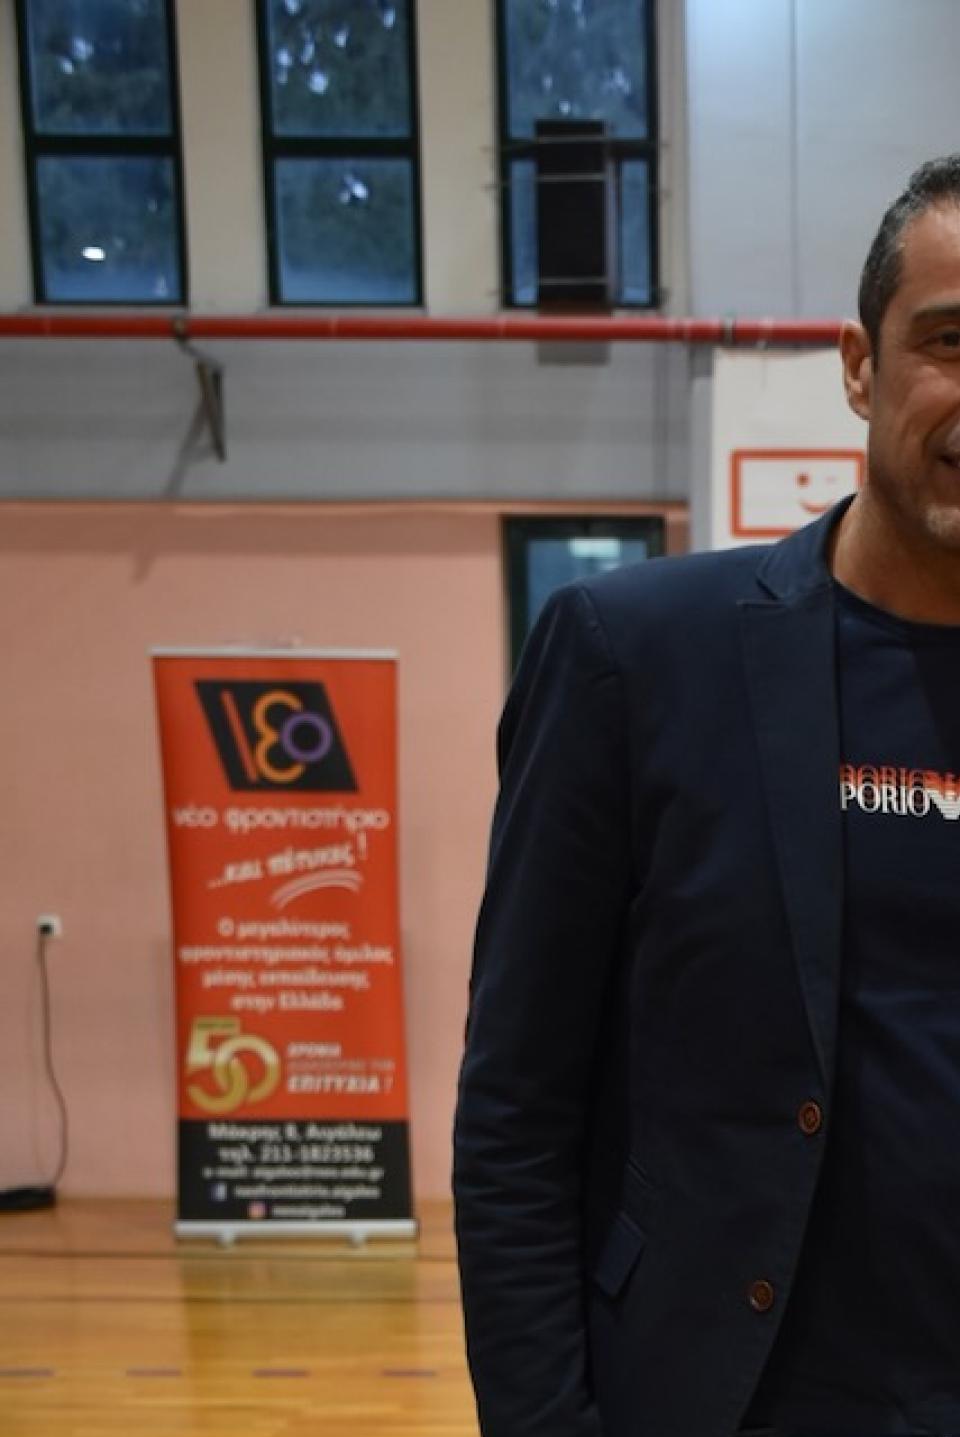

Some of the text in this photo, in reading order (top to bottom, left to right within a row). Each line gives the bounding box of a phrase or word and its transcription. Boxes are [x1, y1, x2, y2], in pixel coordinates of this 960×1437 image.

[225, 804, 389, 832] φροντιστήριο
[839, 772, 930, 818] PORIO
[187, 1016, 281, 1113] 50
